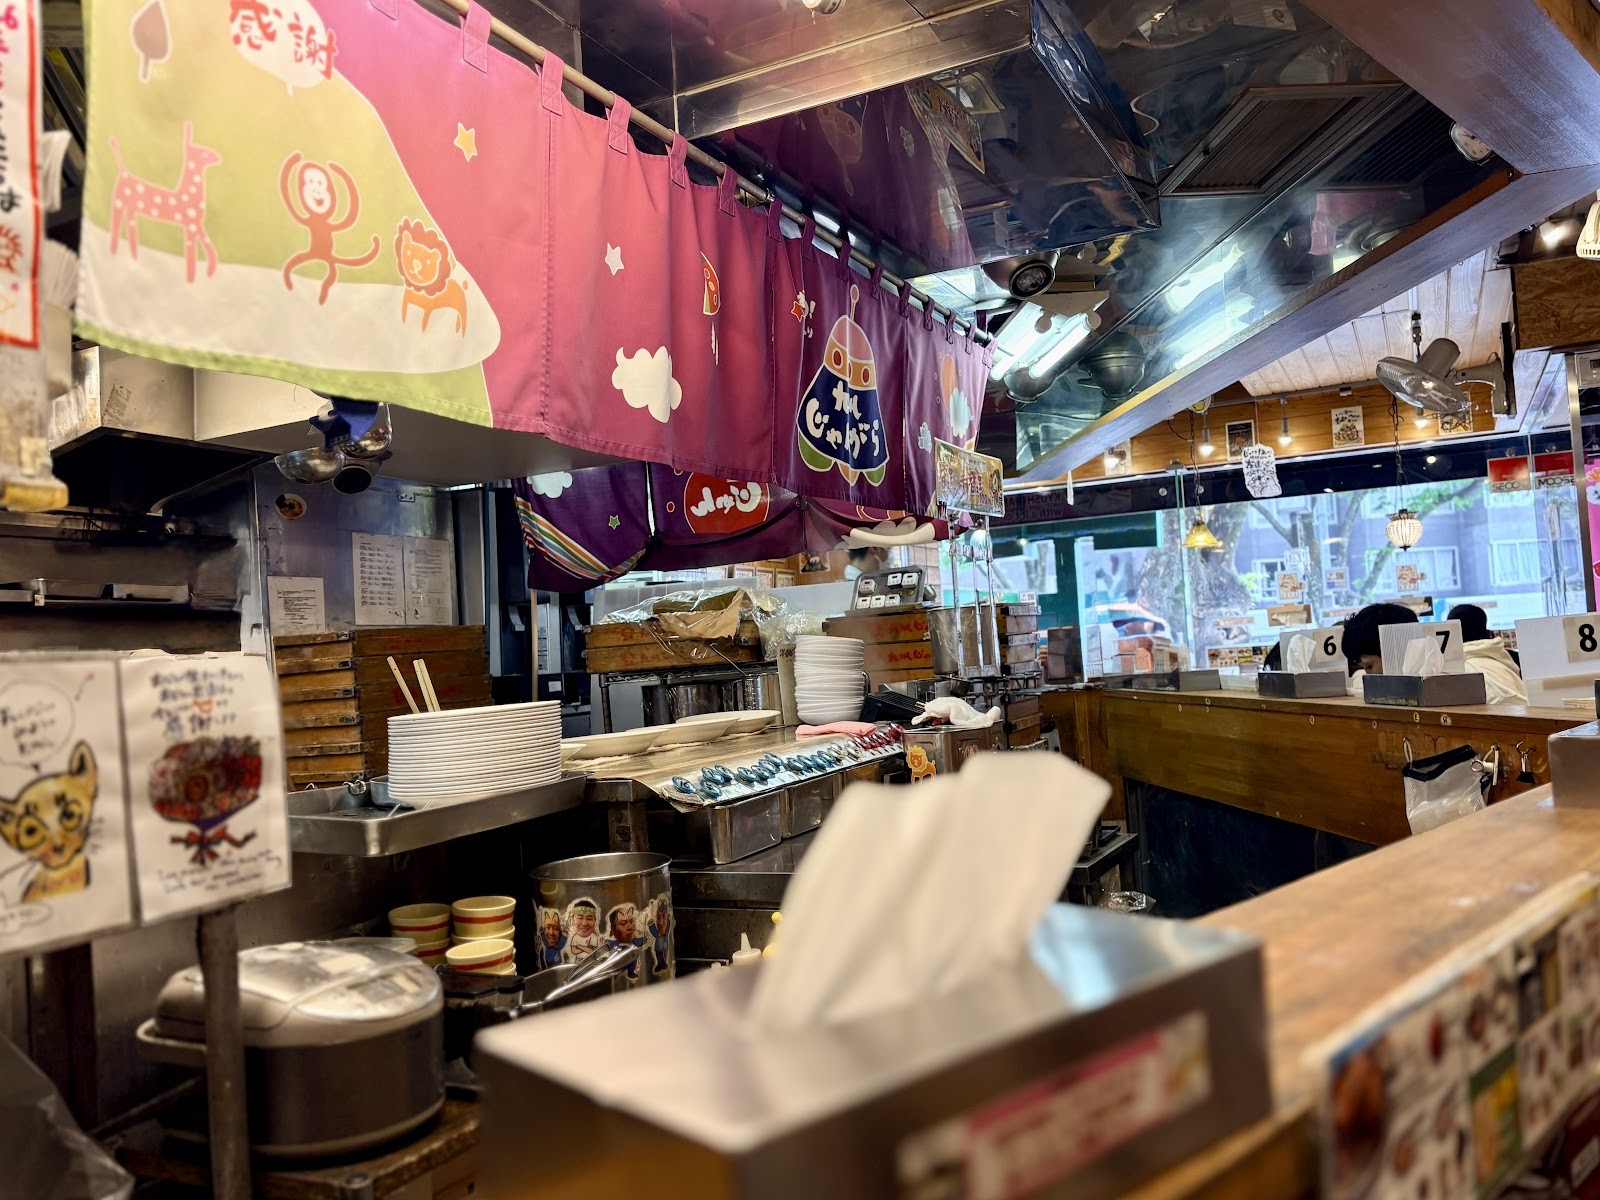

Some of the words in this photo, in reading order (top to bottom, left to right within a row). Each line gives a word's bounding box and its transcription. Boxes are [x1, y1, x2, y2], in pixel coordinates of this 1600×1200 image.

[1323, 636, 1337, 656] 6
[1435, 631, 1450, 654] 7
[1579, 624, 1597, 652] 8
